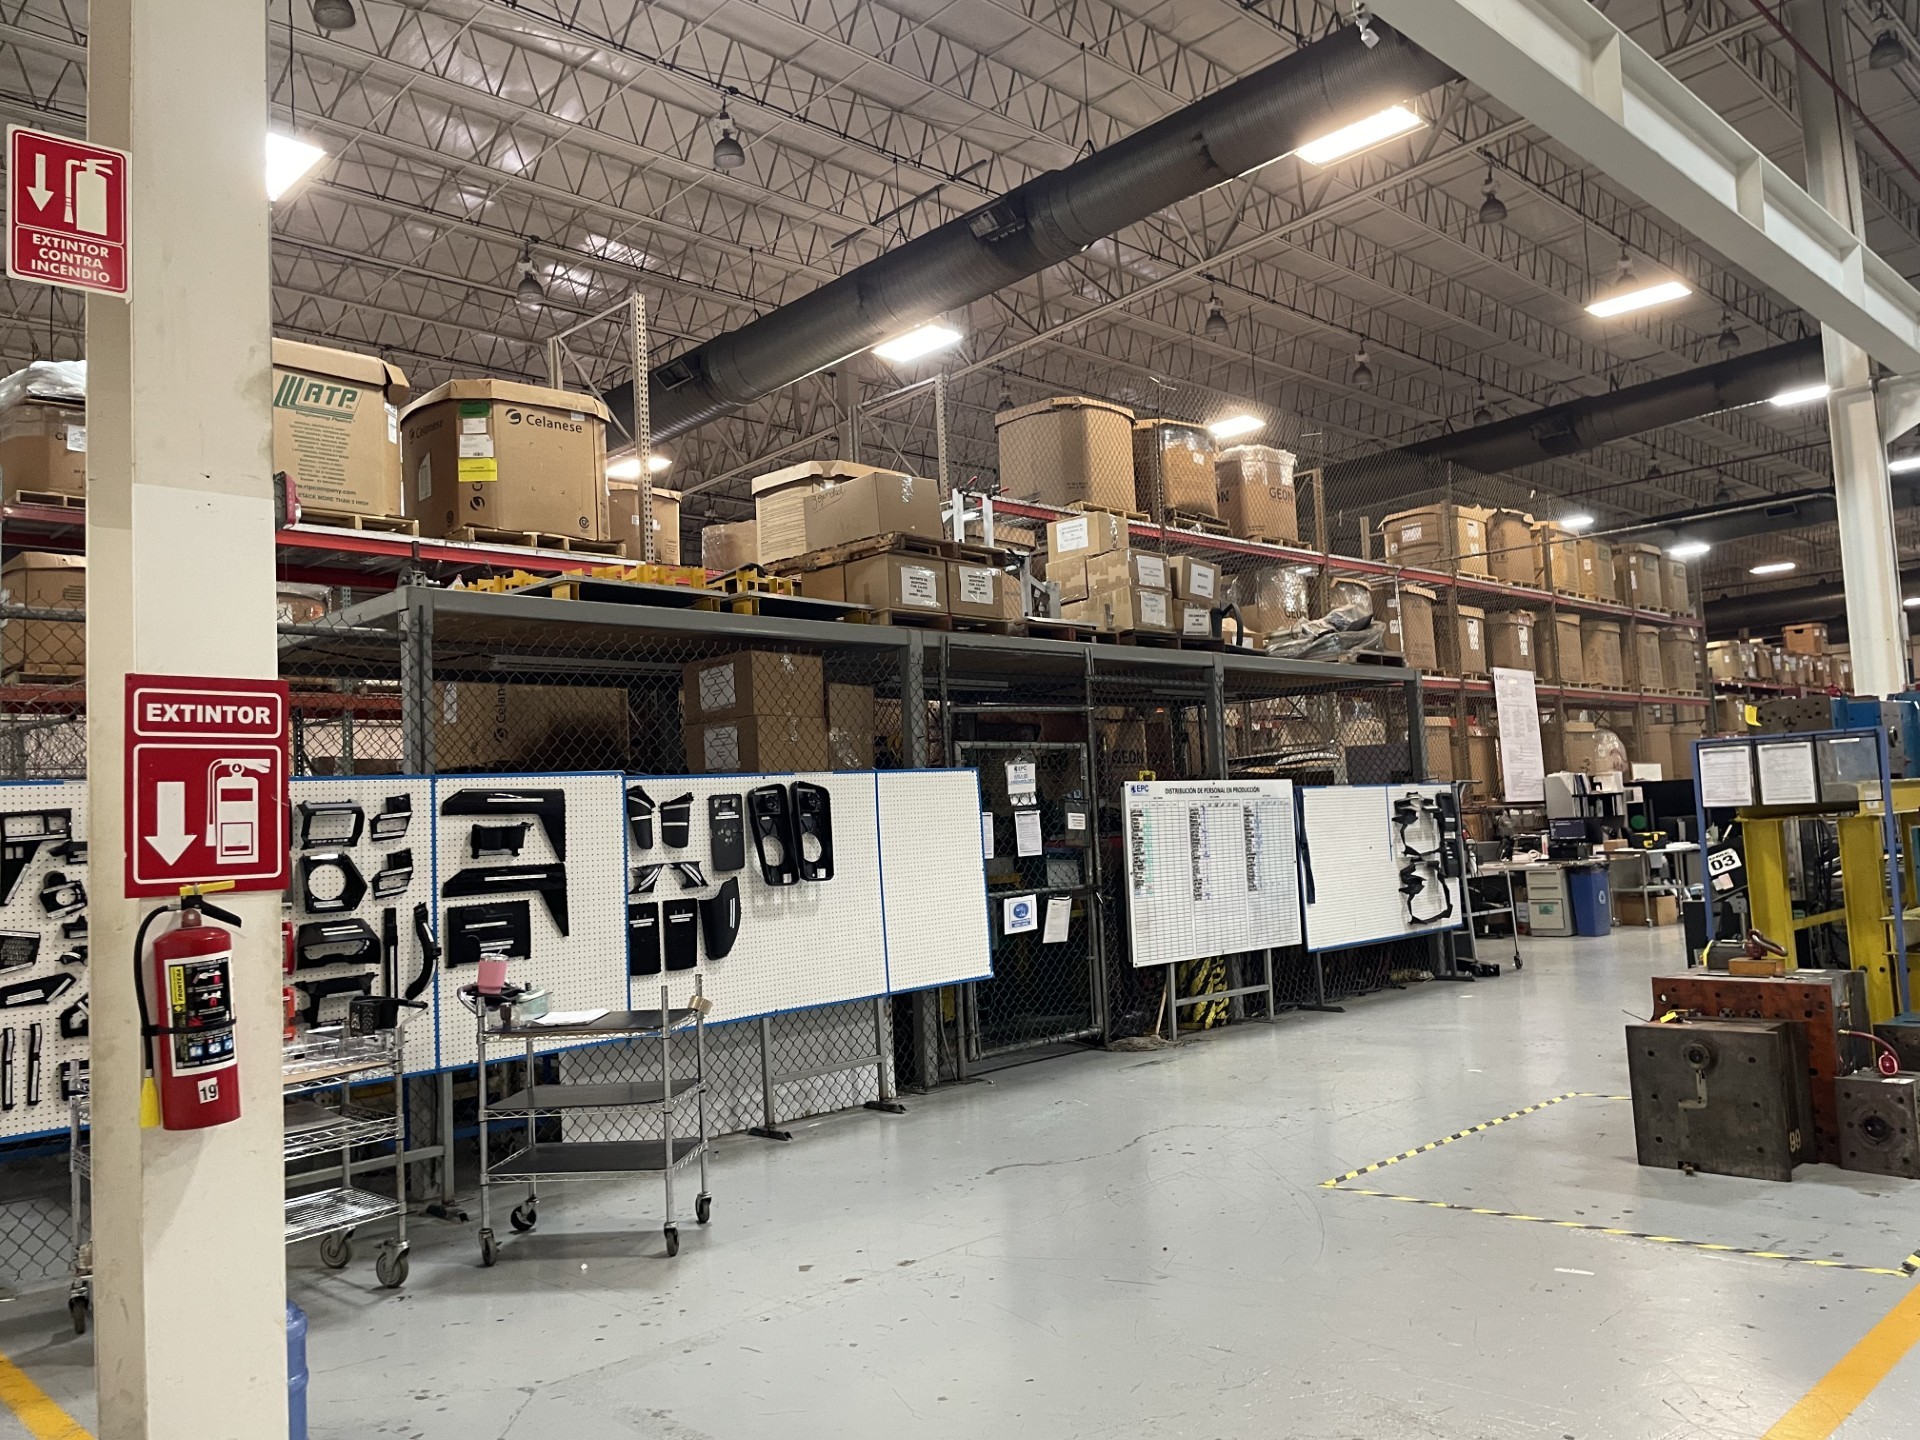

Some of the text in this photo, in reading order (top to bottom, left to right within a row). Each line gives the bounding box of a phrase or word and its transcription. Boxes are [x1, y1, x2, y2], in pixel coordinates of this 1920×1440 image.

[32, 233, 109, 258] EXTINTOR
[39, 248, 103, 270] CONTRA
[31, 259, 110, 283] INCENDIO
[526, 414, 582, 433] Celanese
[146, 703, 271, 725] EXTINTOR
[1136, 784, 1149, 793] EPC
[1165, 786, 1197, 794] DISTRIBUCIÓN
[1232, 785, 1260, 793] PRODUCCIÓN
[1711, 855, 1735, 870] 03
[176, 968, 184, 1002] FRONTERA
[200, 1085, 217, 1101] 19
